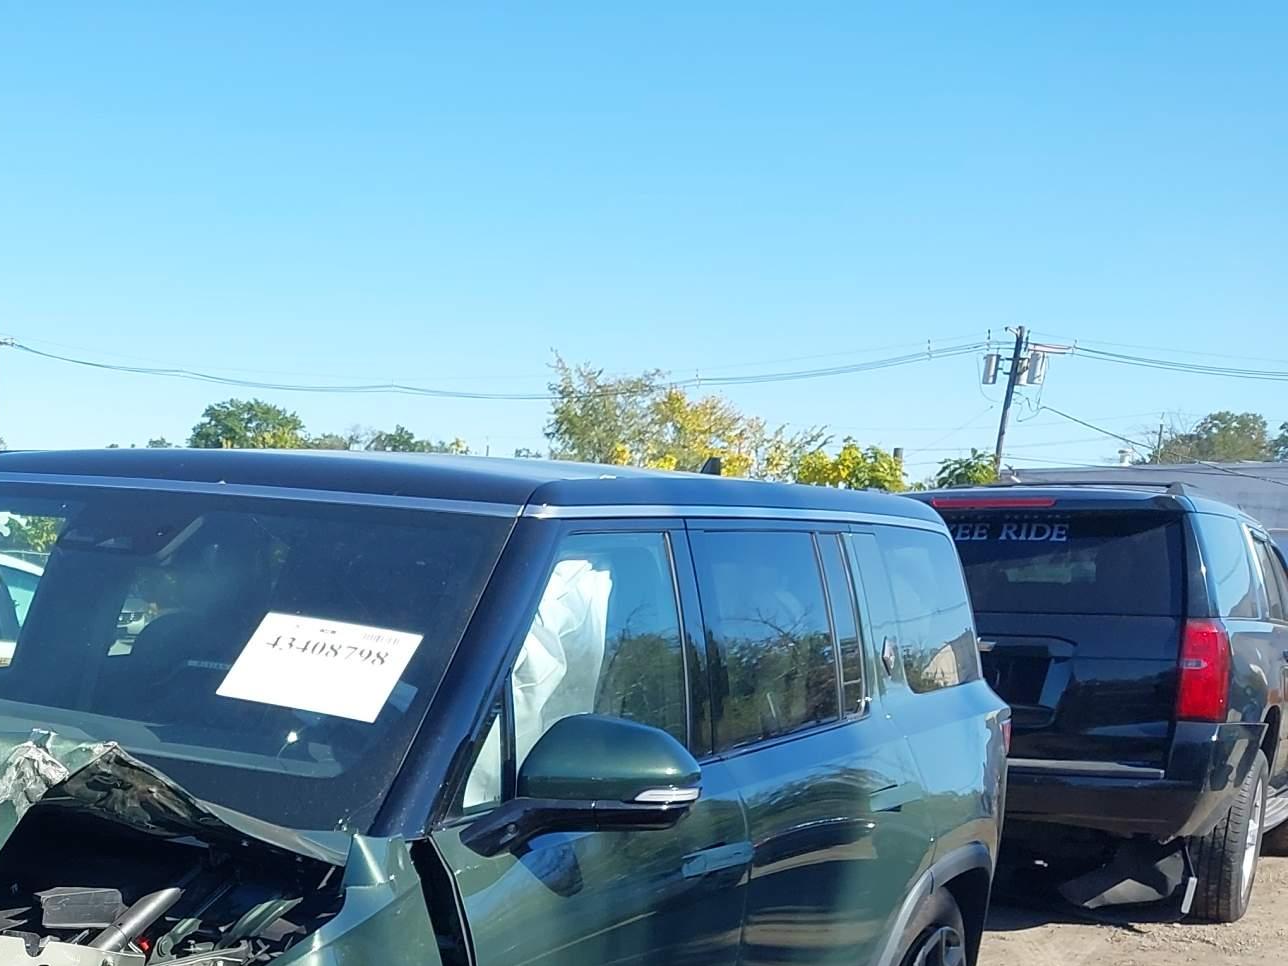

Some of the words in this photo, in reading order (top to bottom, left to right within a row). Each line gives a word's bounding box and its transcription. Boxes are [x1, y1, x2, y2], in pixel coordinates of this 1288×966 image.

[949, 522, 991, 542] EE
[998, 522, 1070, 542] RIDE
[266, 634, 389, 665] 43408798
